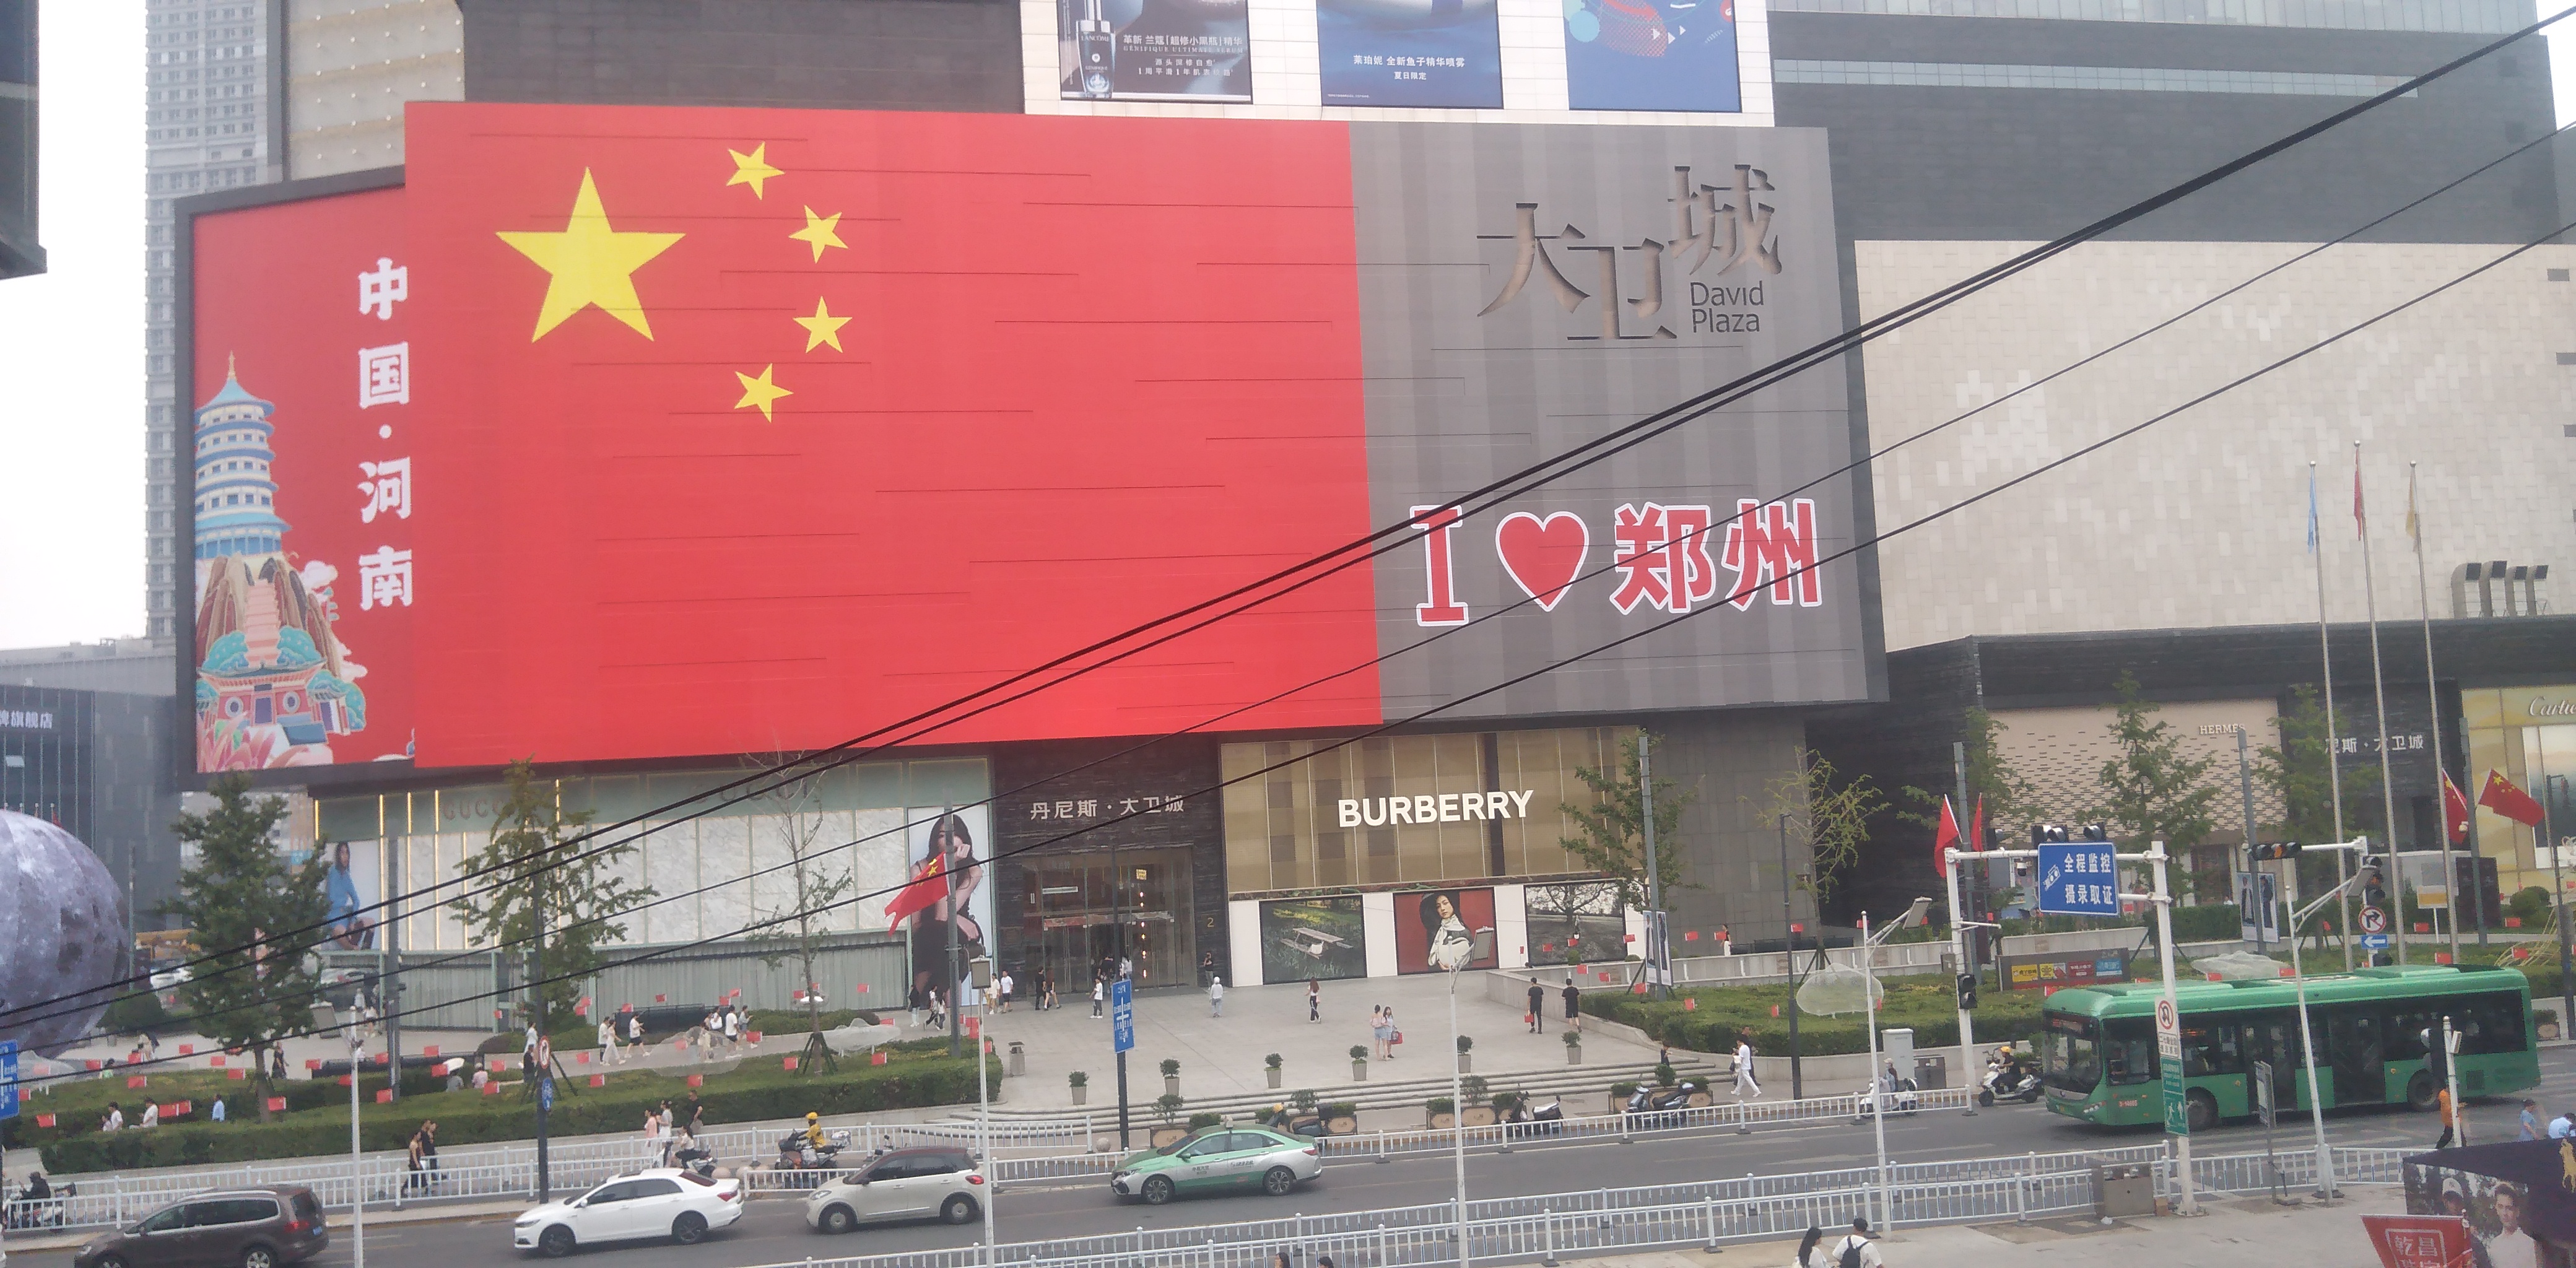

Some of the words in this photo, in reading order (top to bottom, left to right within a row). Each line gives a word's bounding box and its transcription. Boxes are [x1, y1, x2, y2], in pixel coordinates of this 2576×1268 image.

[1123, 35, 1142, 45] 革新
[1353, 54, 1383, 66] 莱珀妮
[1386, 55, 1465, 67] 全新鱼子精华喷雾
[1394, 71, 1427, 80] 夏日限定
[1477, 164, 1782, 341] 大卫城
[1690, 280, 1764, 306] David
[1692, 308, 1760, 333] Plaza
[358, 257, 413, 611] 中国·河南
[1410, 505, 1469, 626] I
[1609, 498, 1822, 615] 郑州
[443, 798, 505, 820] GUCC
[1338, 790, 1533, 828] BURBERRY
[2064, 853, 2111, 873] 全程监控
[2065, 884, 2113, 905] 摄录取证
[1207, 917, 1214, 927] 2
[2395, 1235, 2438, 1257] 乾昌
